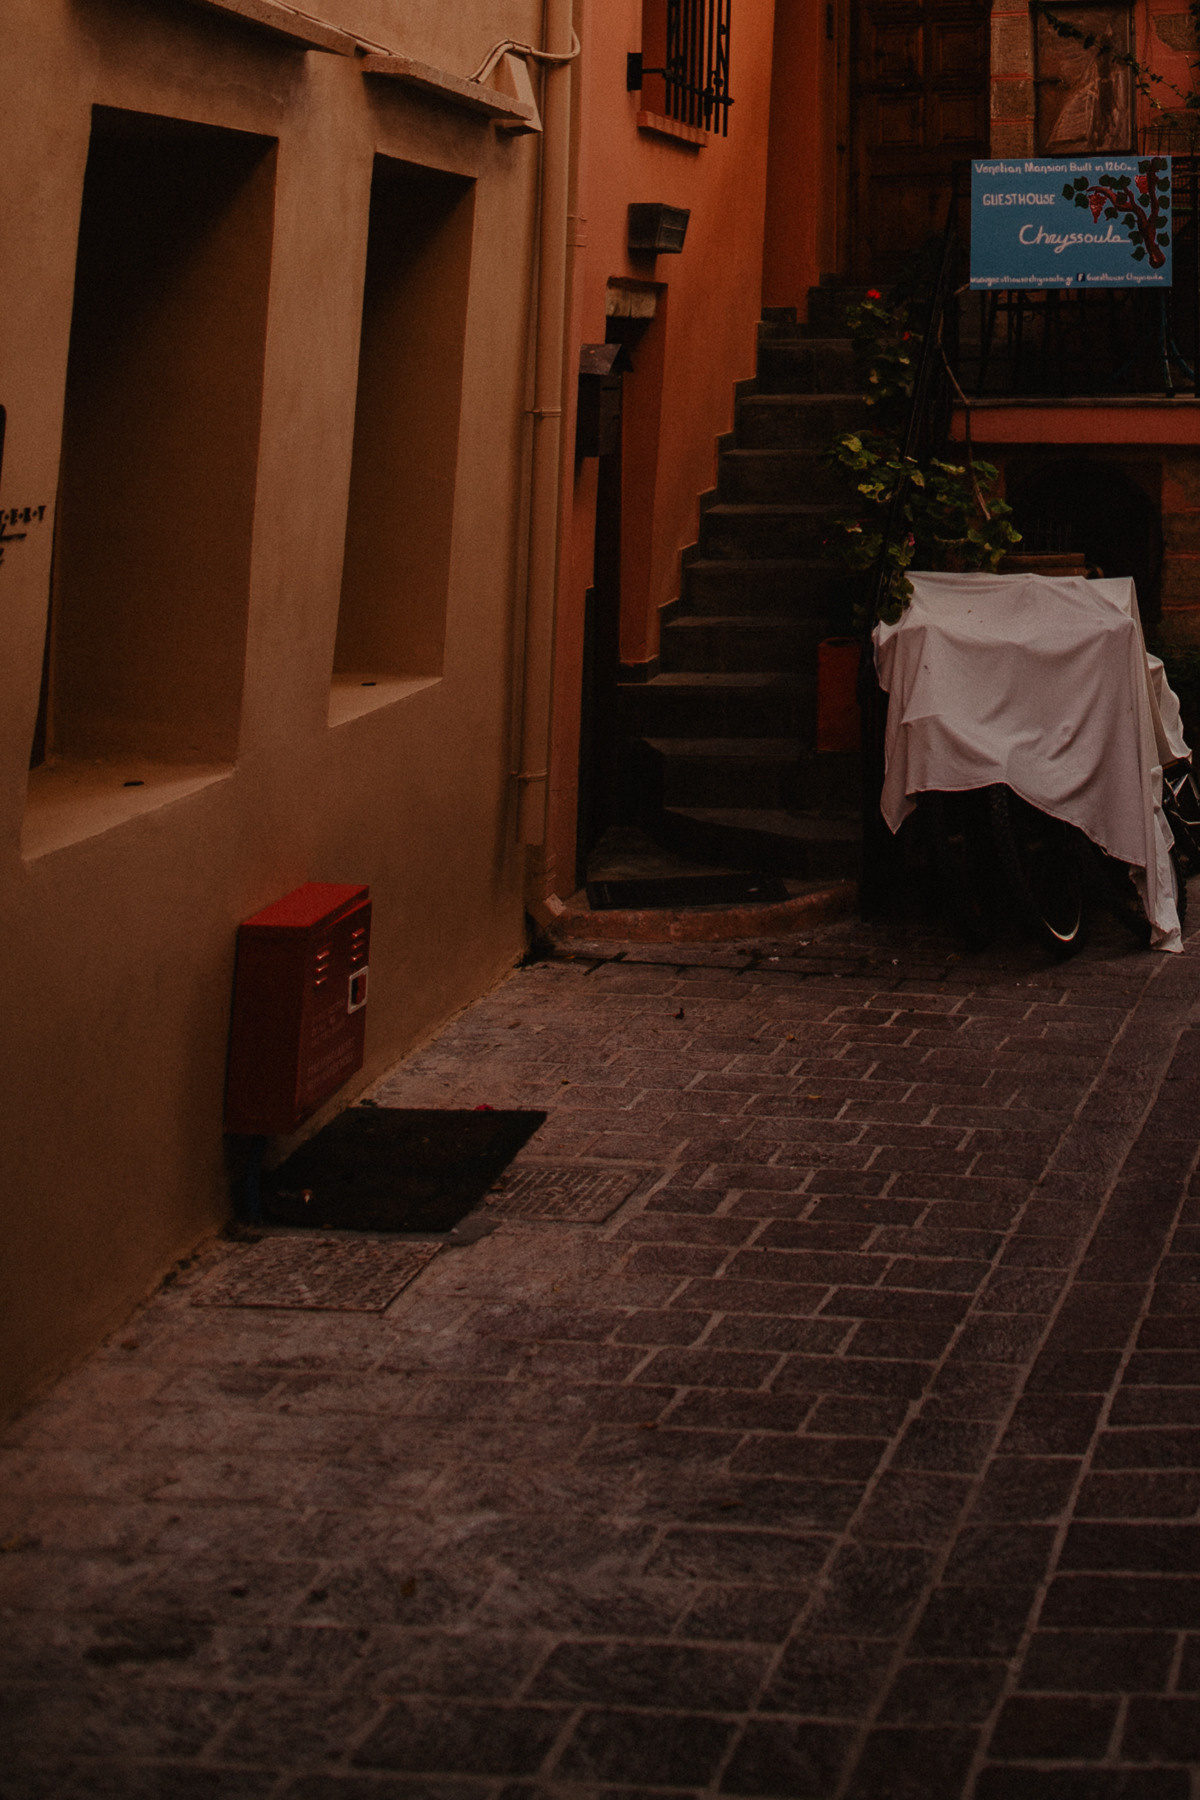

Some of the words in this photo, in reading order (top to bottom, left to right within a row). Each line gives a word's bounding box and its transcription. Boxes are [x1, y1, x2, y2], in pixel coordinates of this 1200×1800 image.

[975, 162, 1021, 175] Venetian
[1025, 162, 1067, 174] Mansion
[1070, 162, 1092, 172] Built
[1095, 165, 1104, 173] in
[983, 193, 1056, 206] GUESTHOUSE
[1018, 224, 1131, 254] Chryssoula
